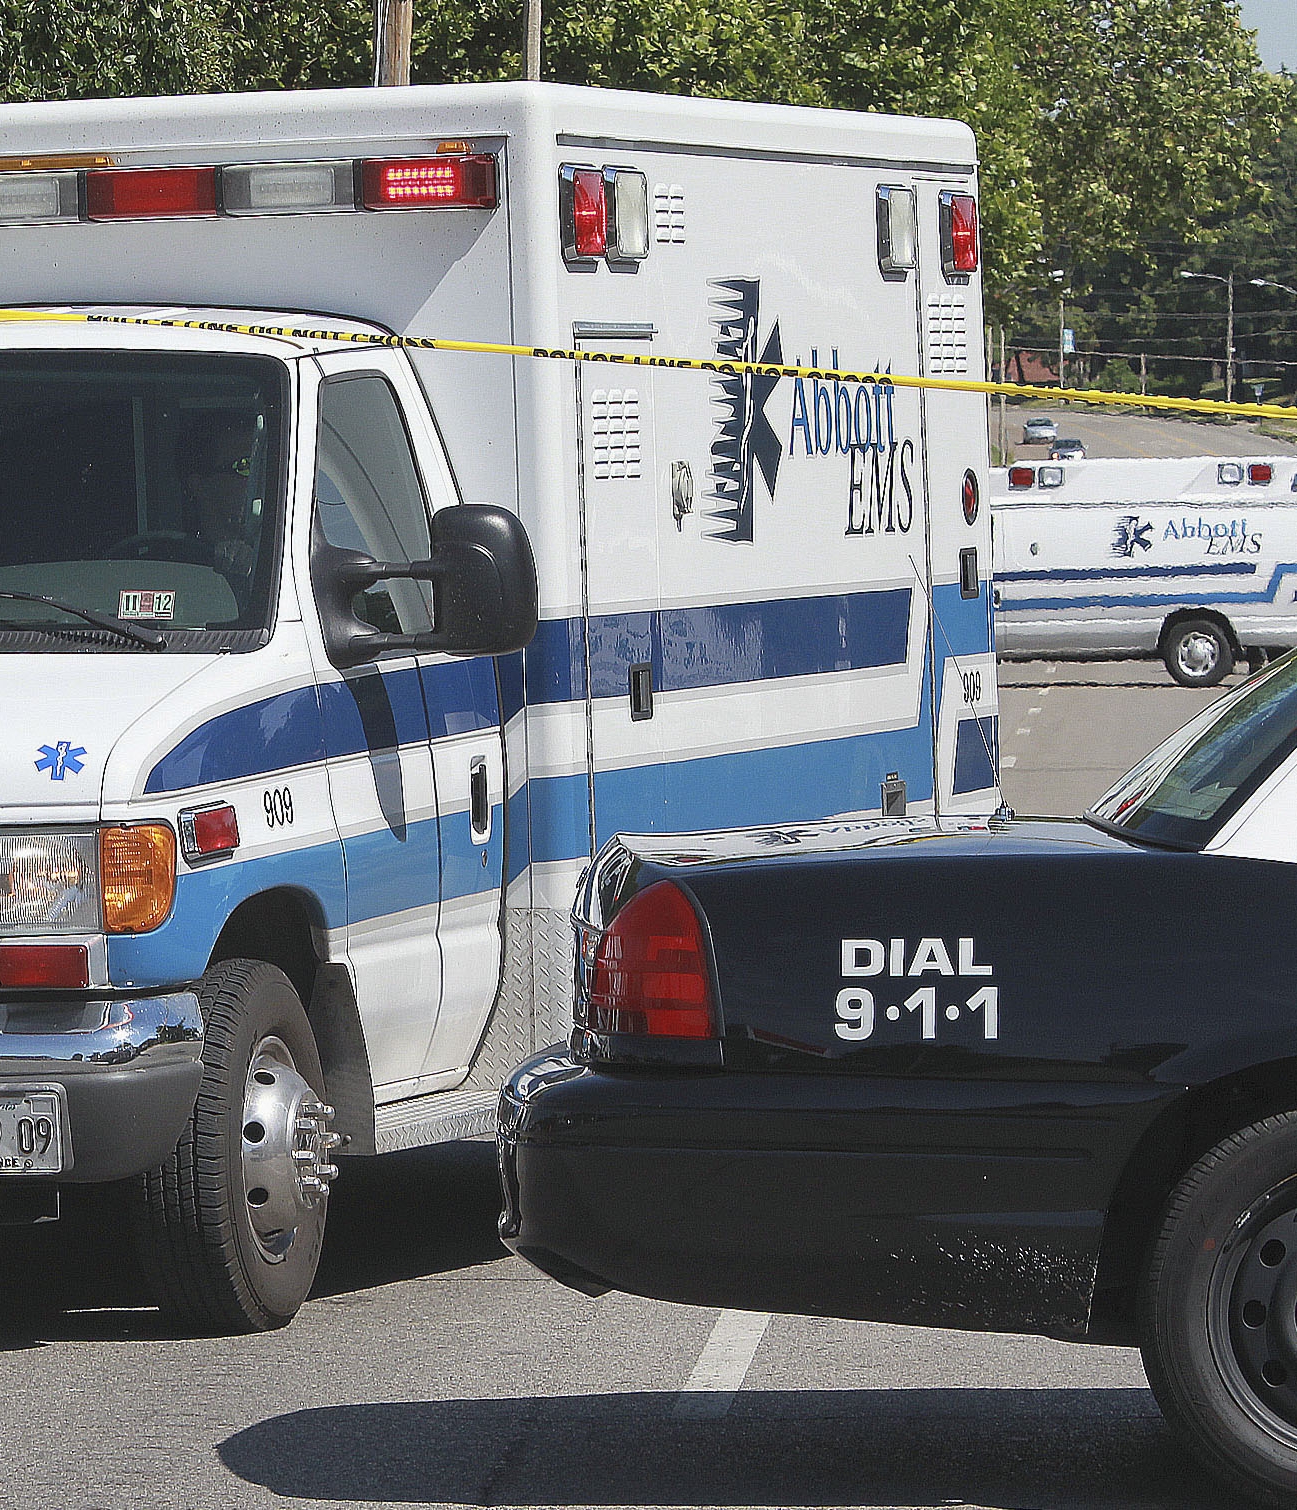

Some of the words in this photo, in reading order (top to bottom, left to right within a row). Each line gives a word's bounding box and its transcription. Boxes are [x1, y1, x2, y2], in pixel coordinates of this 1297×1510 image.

[789, 346, 896, 457] Abbott
[845, 439, 916, 537] EMS
[1163, 517, 1248, 541] Abbott
[1205, 533, 1262, 555] EMS
[155, 594, 171, 611] 12
[264, 787, 293, 828] 909
[841, 938, 993, 977] DIAL
[18, 1116, 54, 1155] 09
